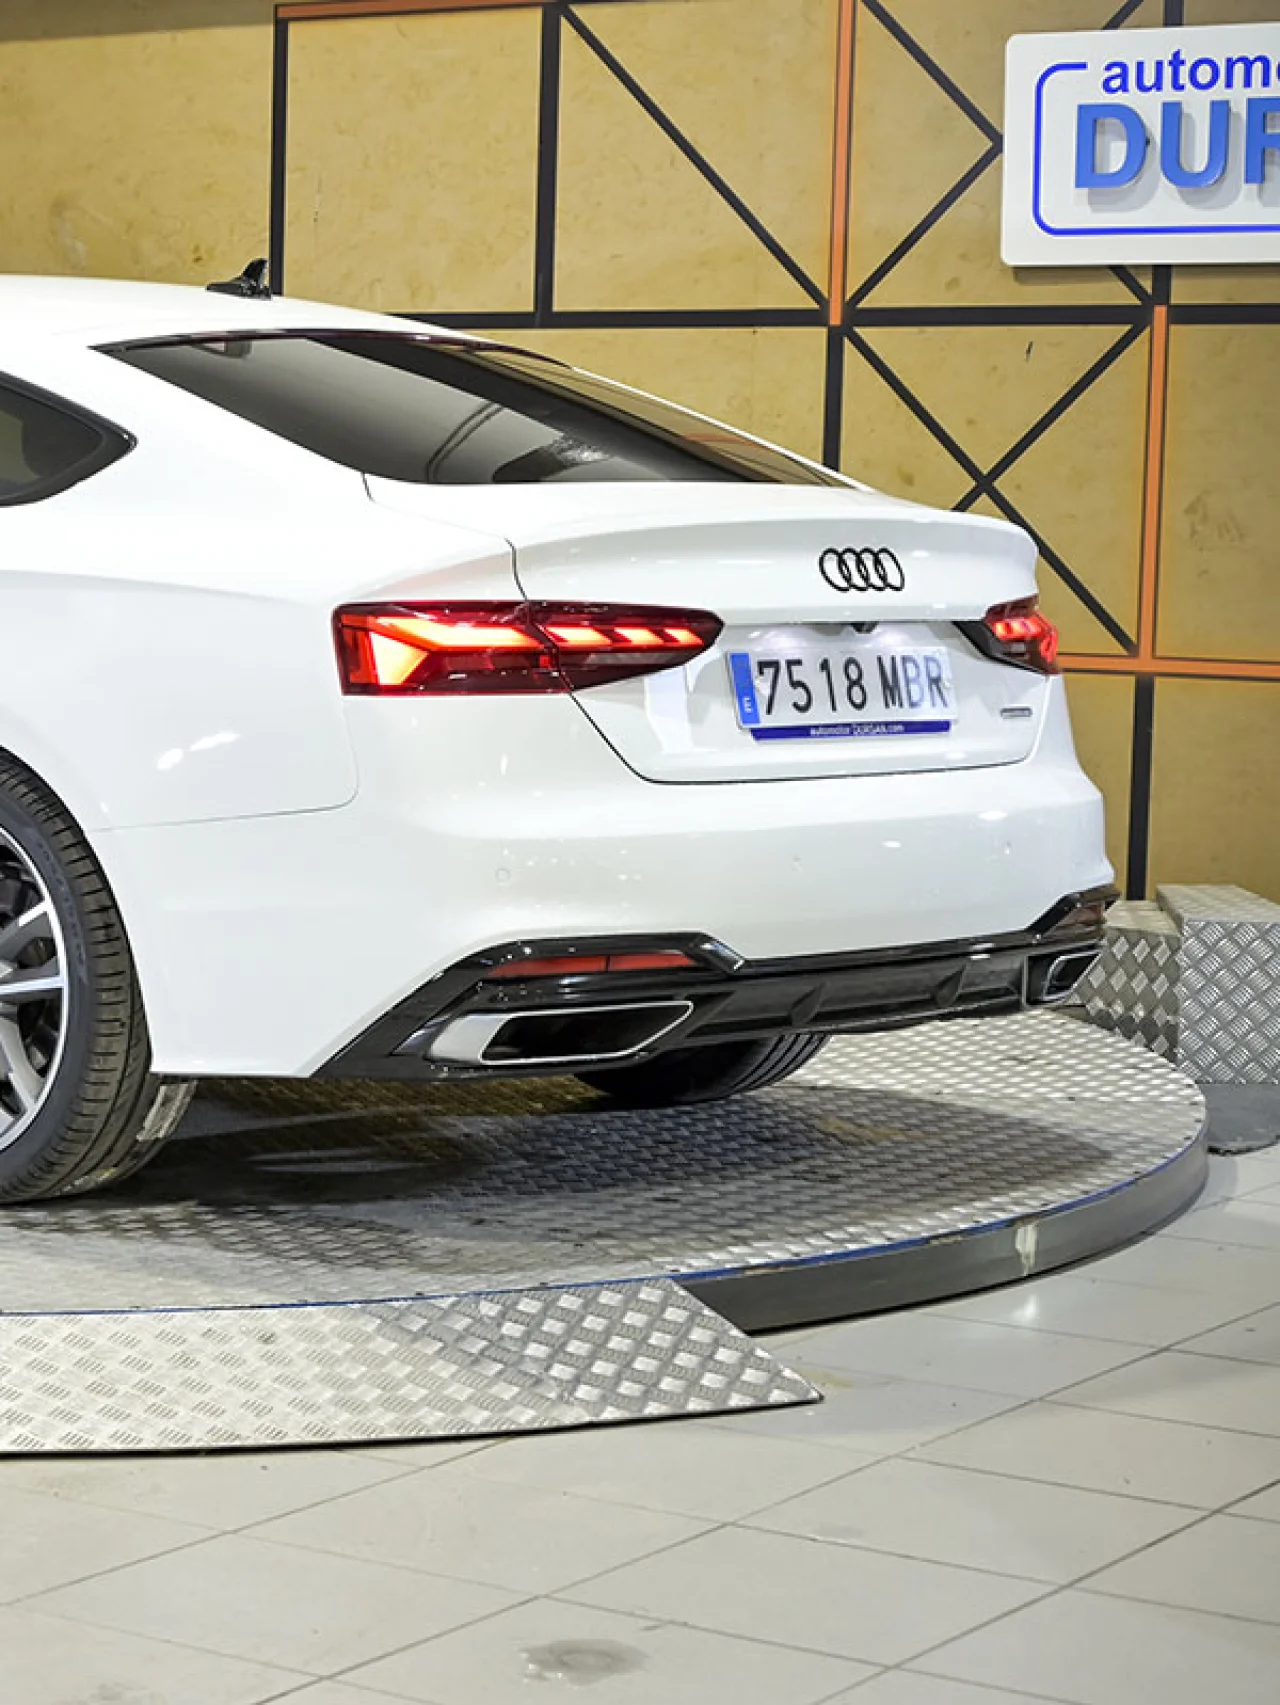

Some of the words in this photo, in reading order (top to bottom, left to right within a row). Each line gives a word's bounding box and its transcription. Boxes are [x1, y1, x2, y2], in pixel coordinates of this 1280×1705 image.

[1102, 49, 1280, 94] autom
[756, 657, 868, 716] 7518
[876, 654, 949, 709] MBR
